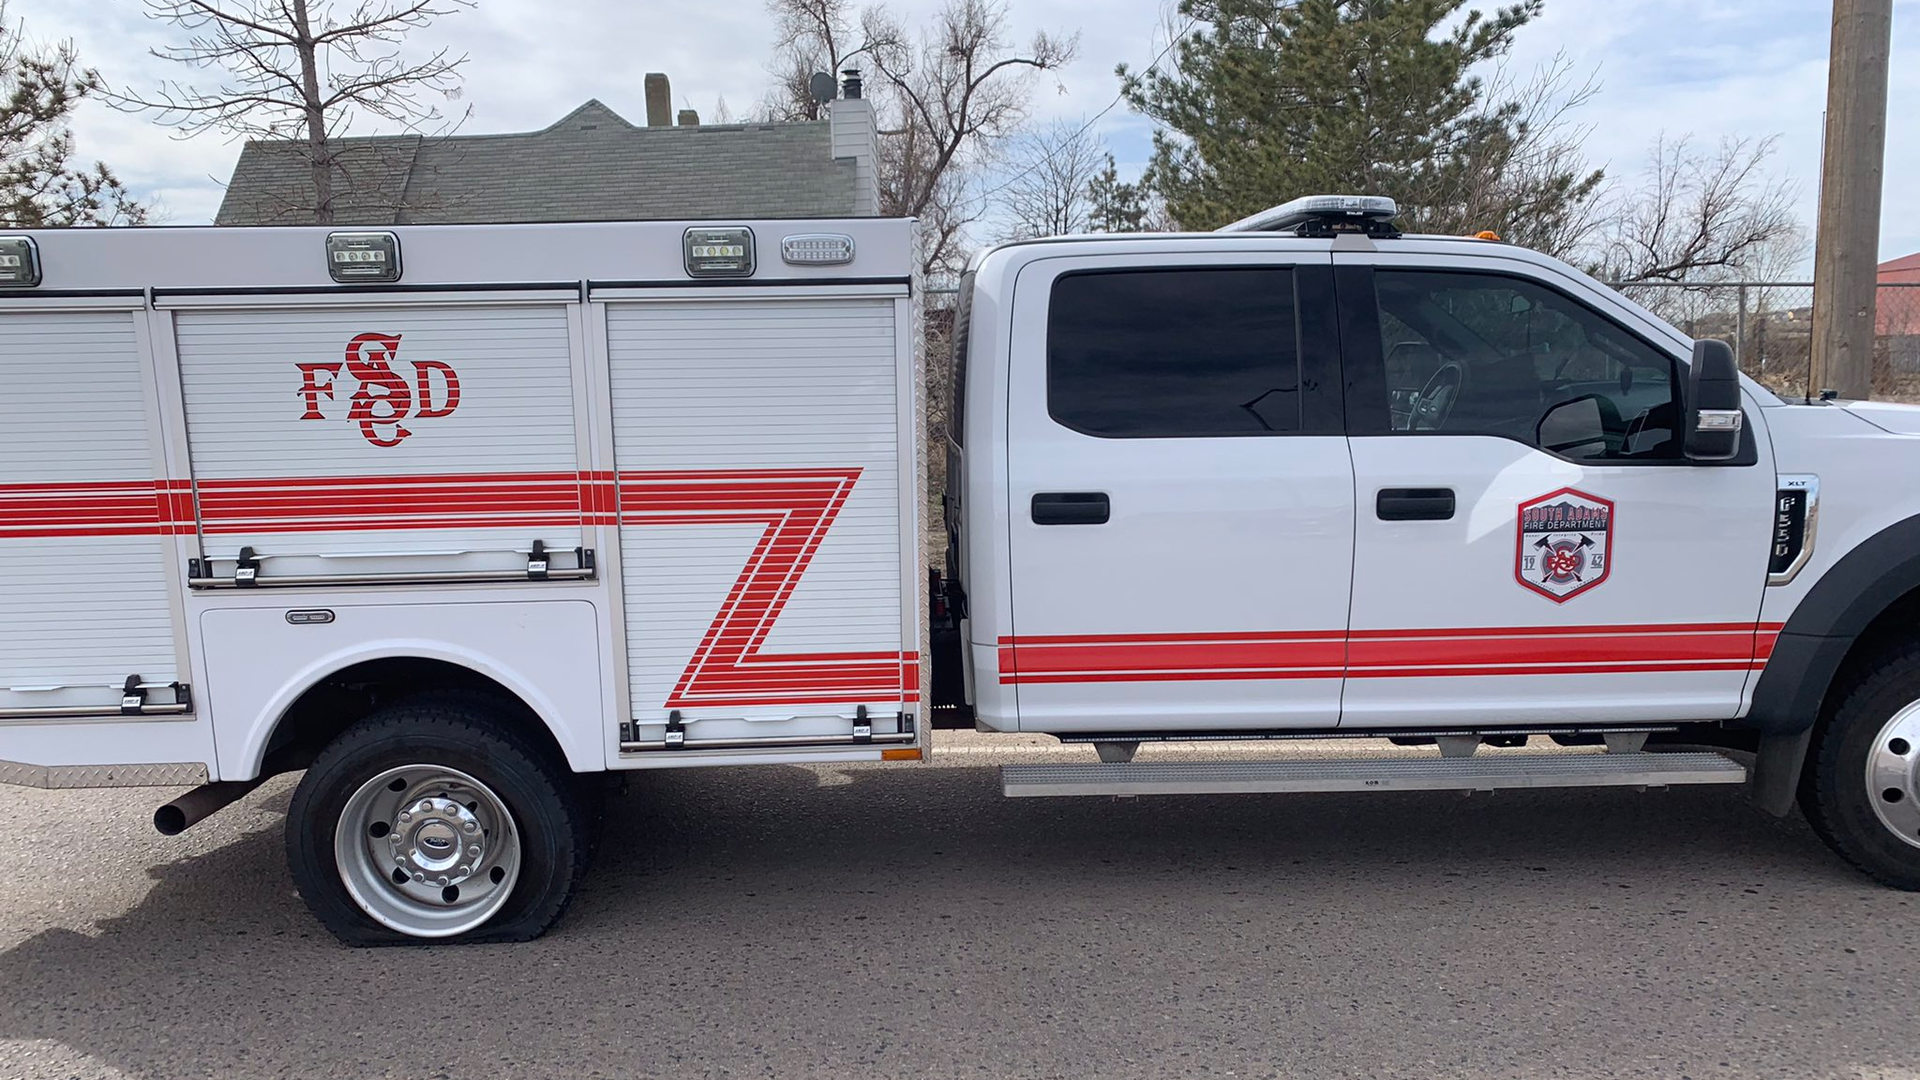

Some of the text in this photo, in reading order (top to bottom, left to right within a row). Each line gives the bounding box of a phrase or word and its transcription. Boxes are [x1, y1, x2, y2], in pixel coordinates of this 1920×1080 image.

[1524, 506, 1608, 522] SOUTH ADAMS
[1524, 520, 1606, 530] FIRE DEPARTMENT
[1524, 557, 1535, 569] 19
[1591, 555, 1603, 568] 42
